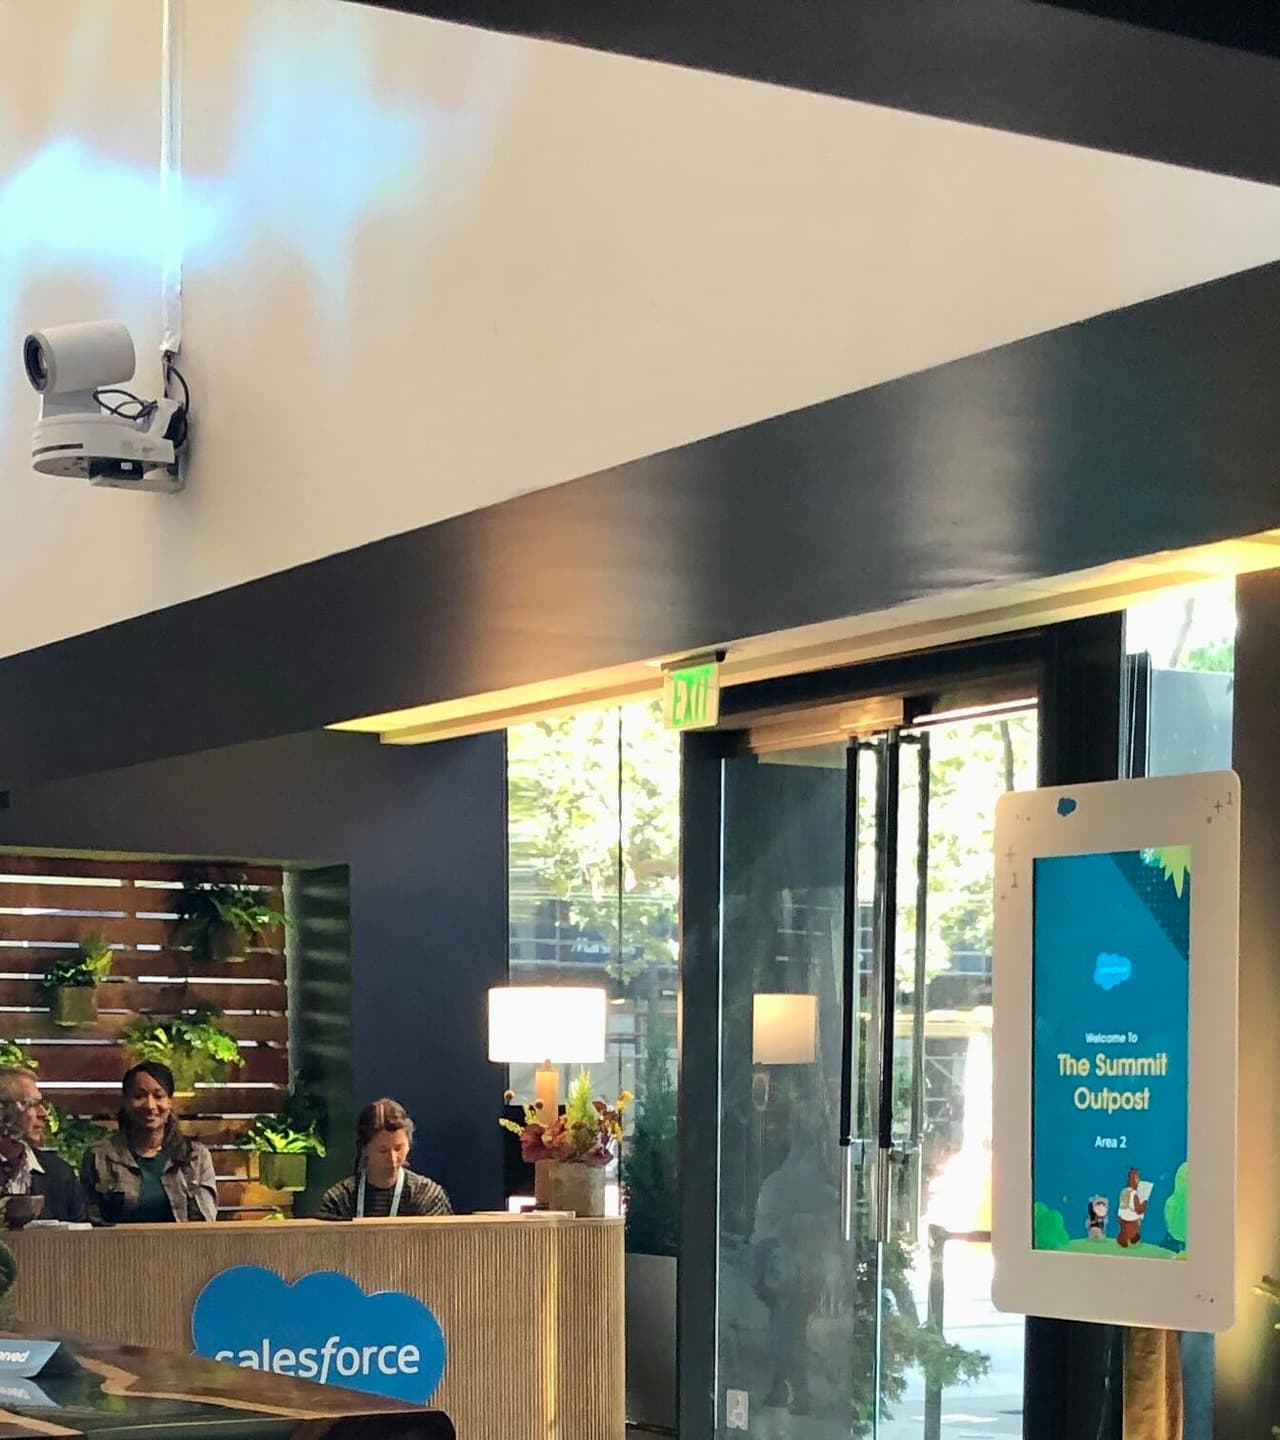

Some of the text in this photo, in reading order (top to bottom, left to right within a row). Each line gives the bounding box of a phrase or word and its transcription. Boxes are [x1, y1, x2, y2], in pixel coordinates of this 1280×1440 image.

[672, 664, 713, 726] EXIT
[1085, 1032, 1138, 1043] Welcome To
[1057, 1052, 1167, 1076] The Summit
[1074, 1086, 1151, 1115] Outpost
[1095, 1135, 1127, 1148] Area 2
